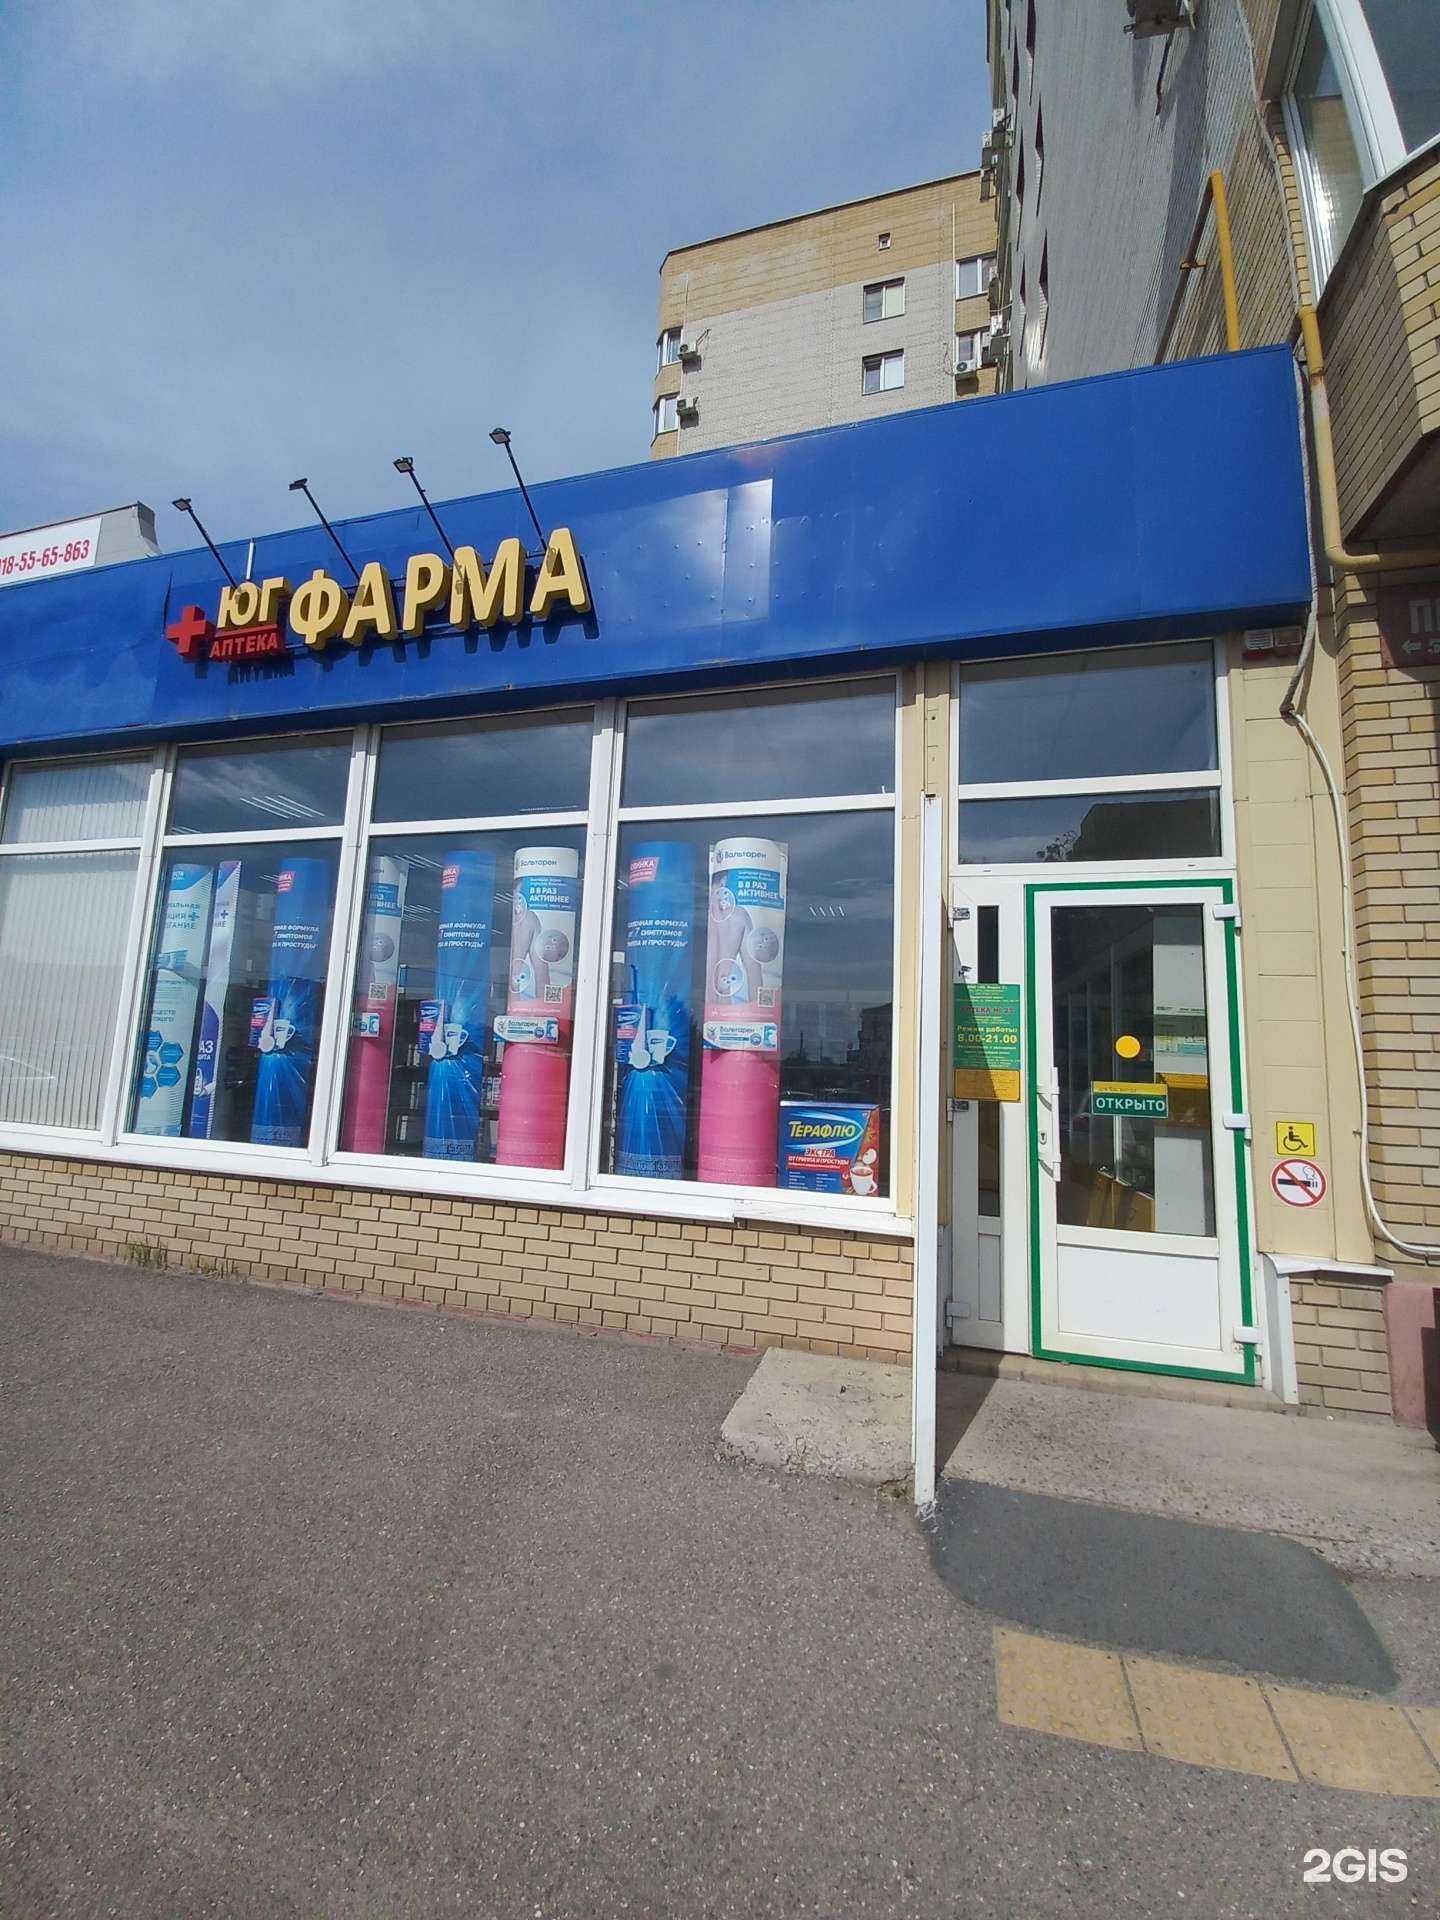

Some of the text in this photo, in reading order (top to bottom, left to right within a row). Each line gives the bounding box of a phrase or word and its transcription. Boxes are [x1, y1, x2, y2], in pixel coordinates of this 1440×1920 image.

[0, 540, 90, 575] 18-55-65-863
[217, 527, 588, 645] ЮГ ФАРМА
[209, 633, 278, 658] АПТЕКА
[957, 1034, 1018, 1043] 8.00-21.00
[1096, 1098, 1165, 1112] ОТКРЫТО
